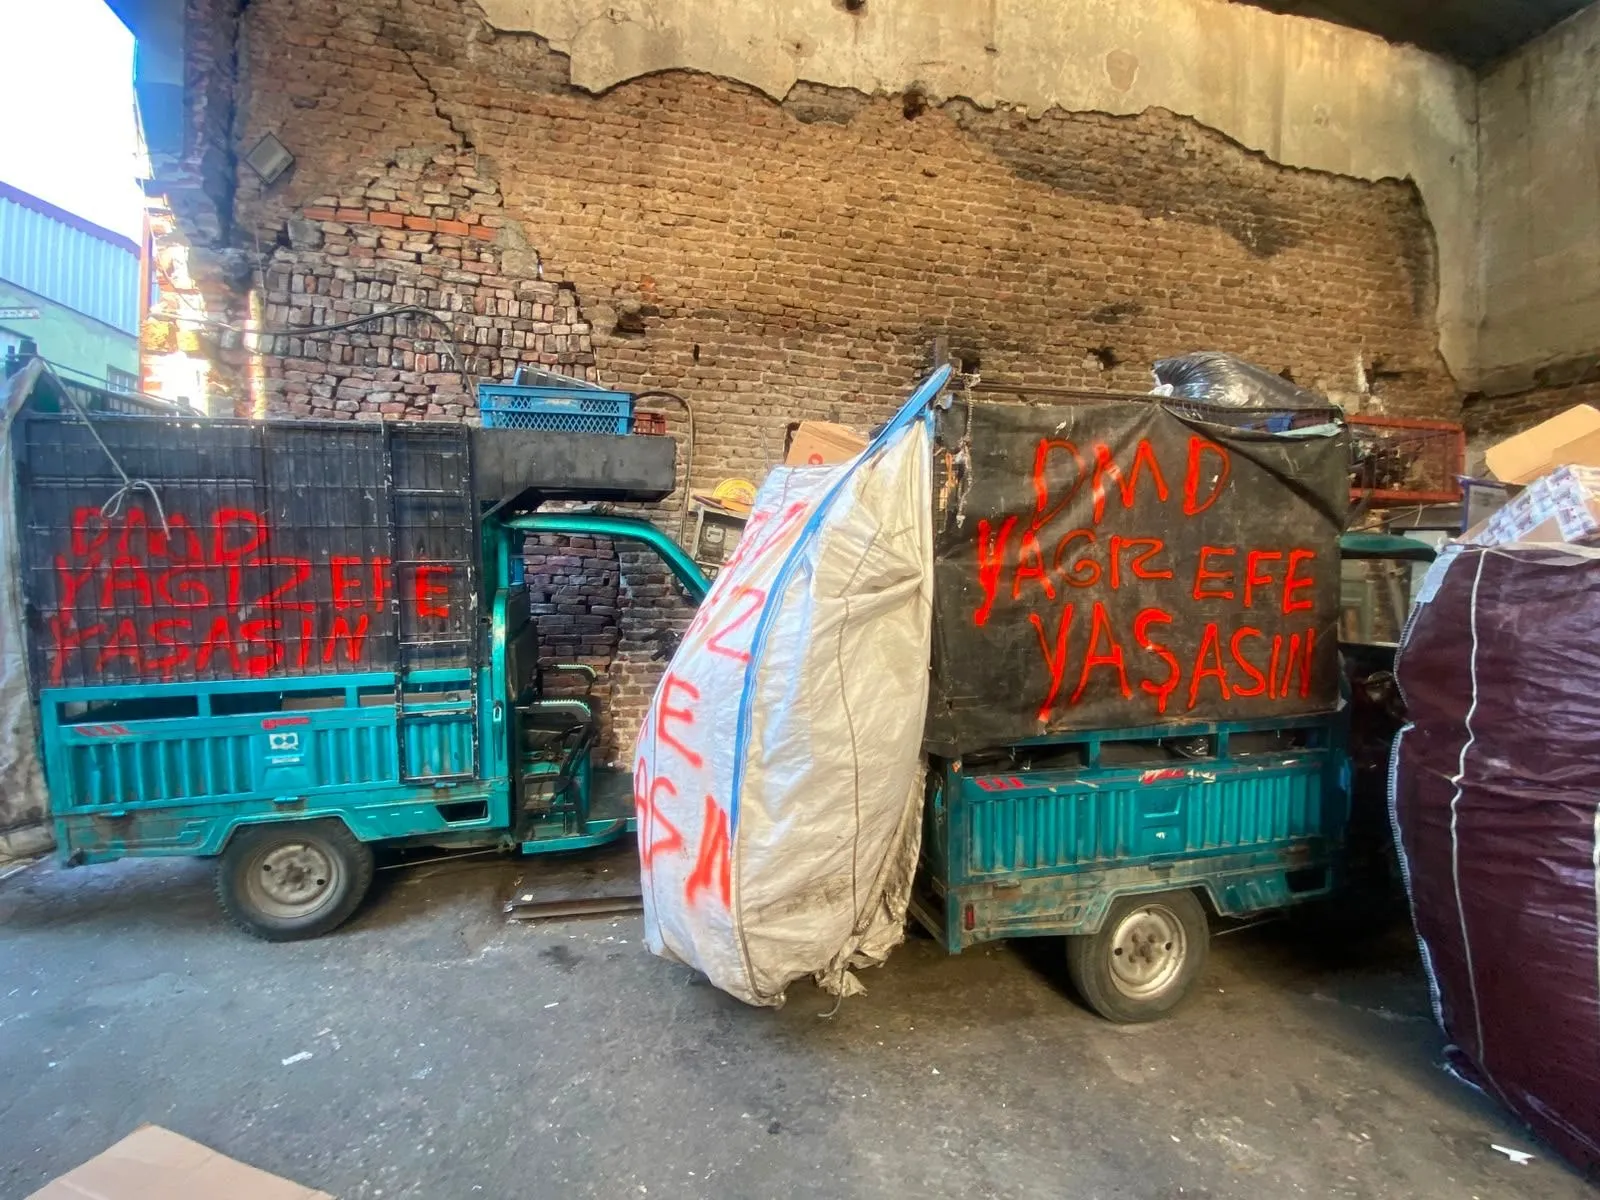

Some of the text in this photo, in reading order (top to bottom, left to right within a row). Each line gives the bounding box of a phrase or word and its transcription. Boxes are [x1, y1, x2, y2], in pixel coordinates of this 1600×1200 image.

[1032, 434, 1230, 531] DMD
[1192, 544, 1317, 617] EFE
[1028, 600, 1316, 722] YAŞASIN
